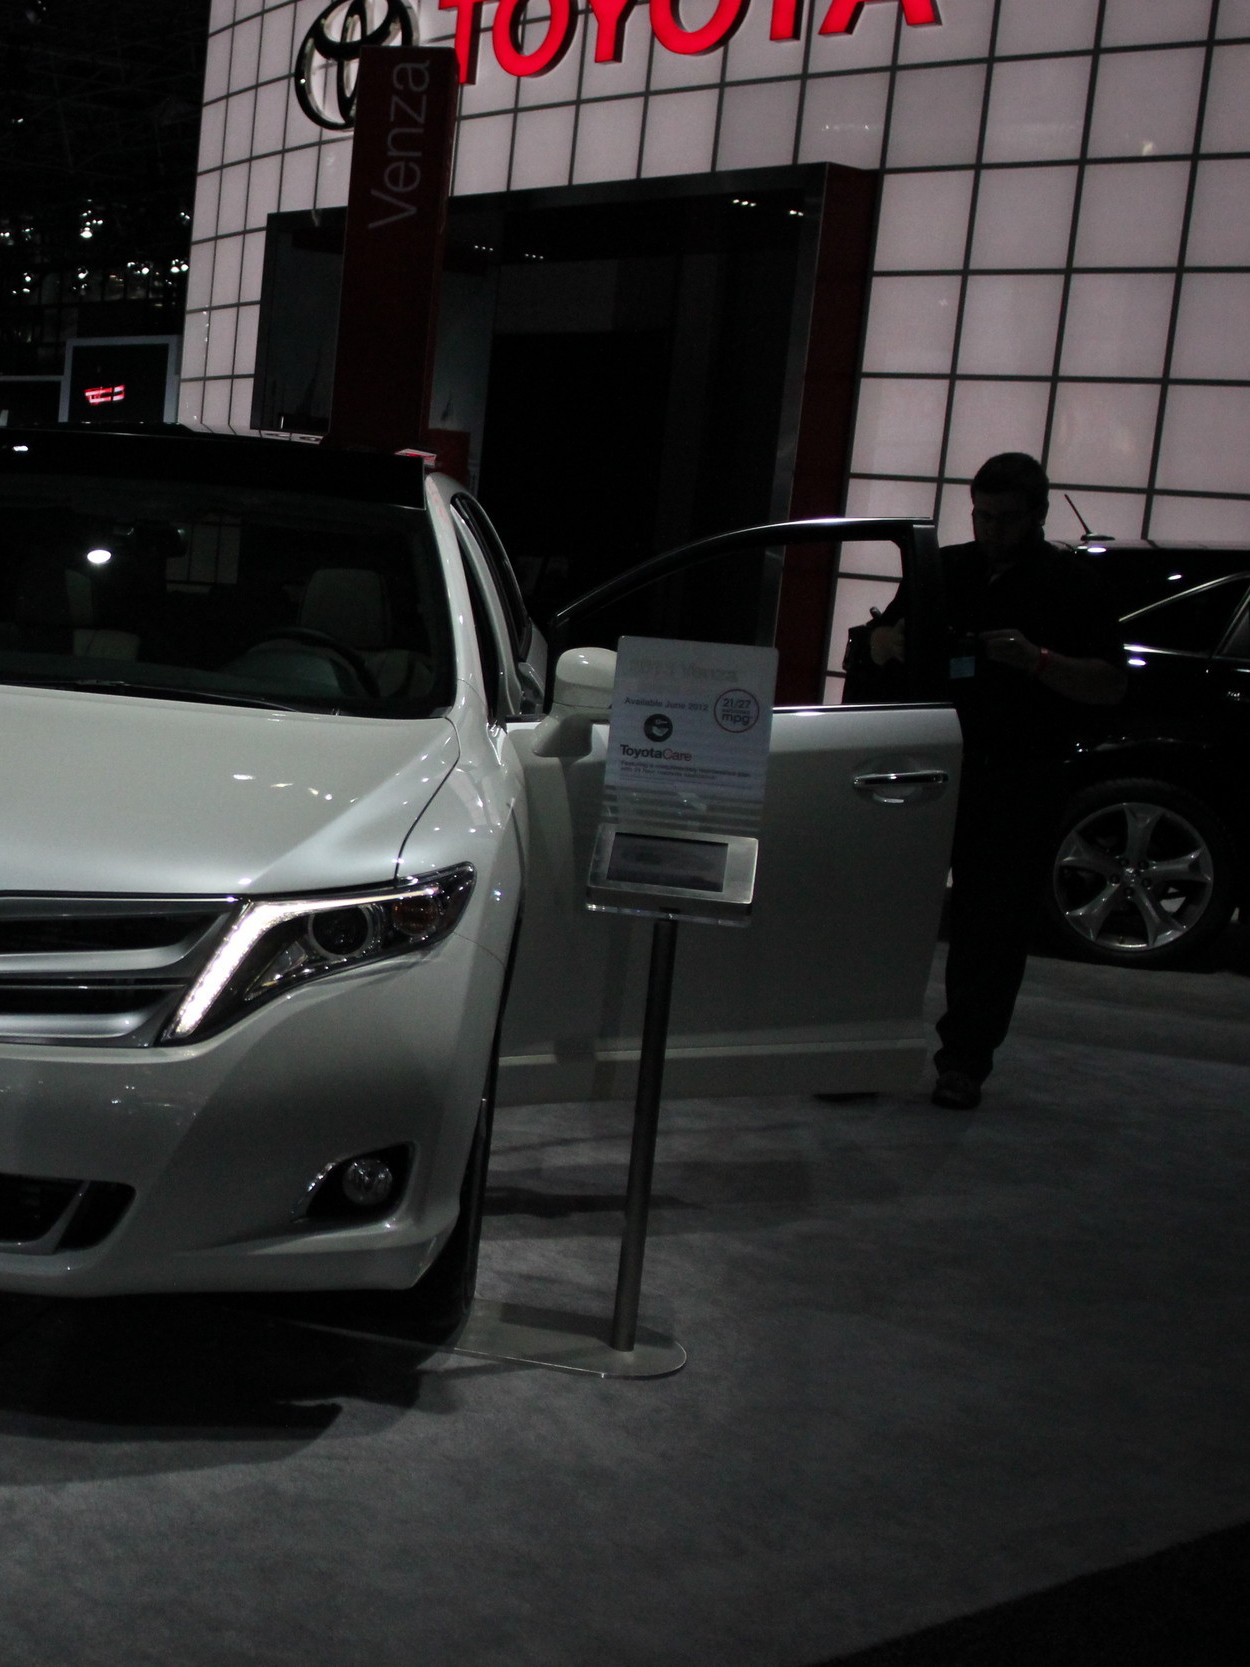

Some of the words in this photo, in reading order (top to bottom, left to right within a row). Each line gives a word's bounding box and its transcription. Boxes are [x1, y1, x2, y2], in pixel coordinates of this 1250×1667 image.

[368, 60, 431, 229] Venza
[624, 697, 663, 708] Available
[664, 701, 686, 710] June
[688, 702, 709, 712] 2012
[722, 698, 752, 709] 21/27
[619, 744, 692, 762] ToyotaCare
